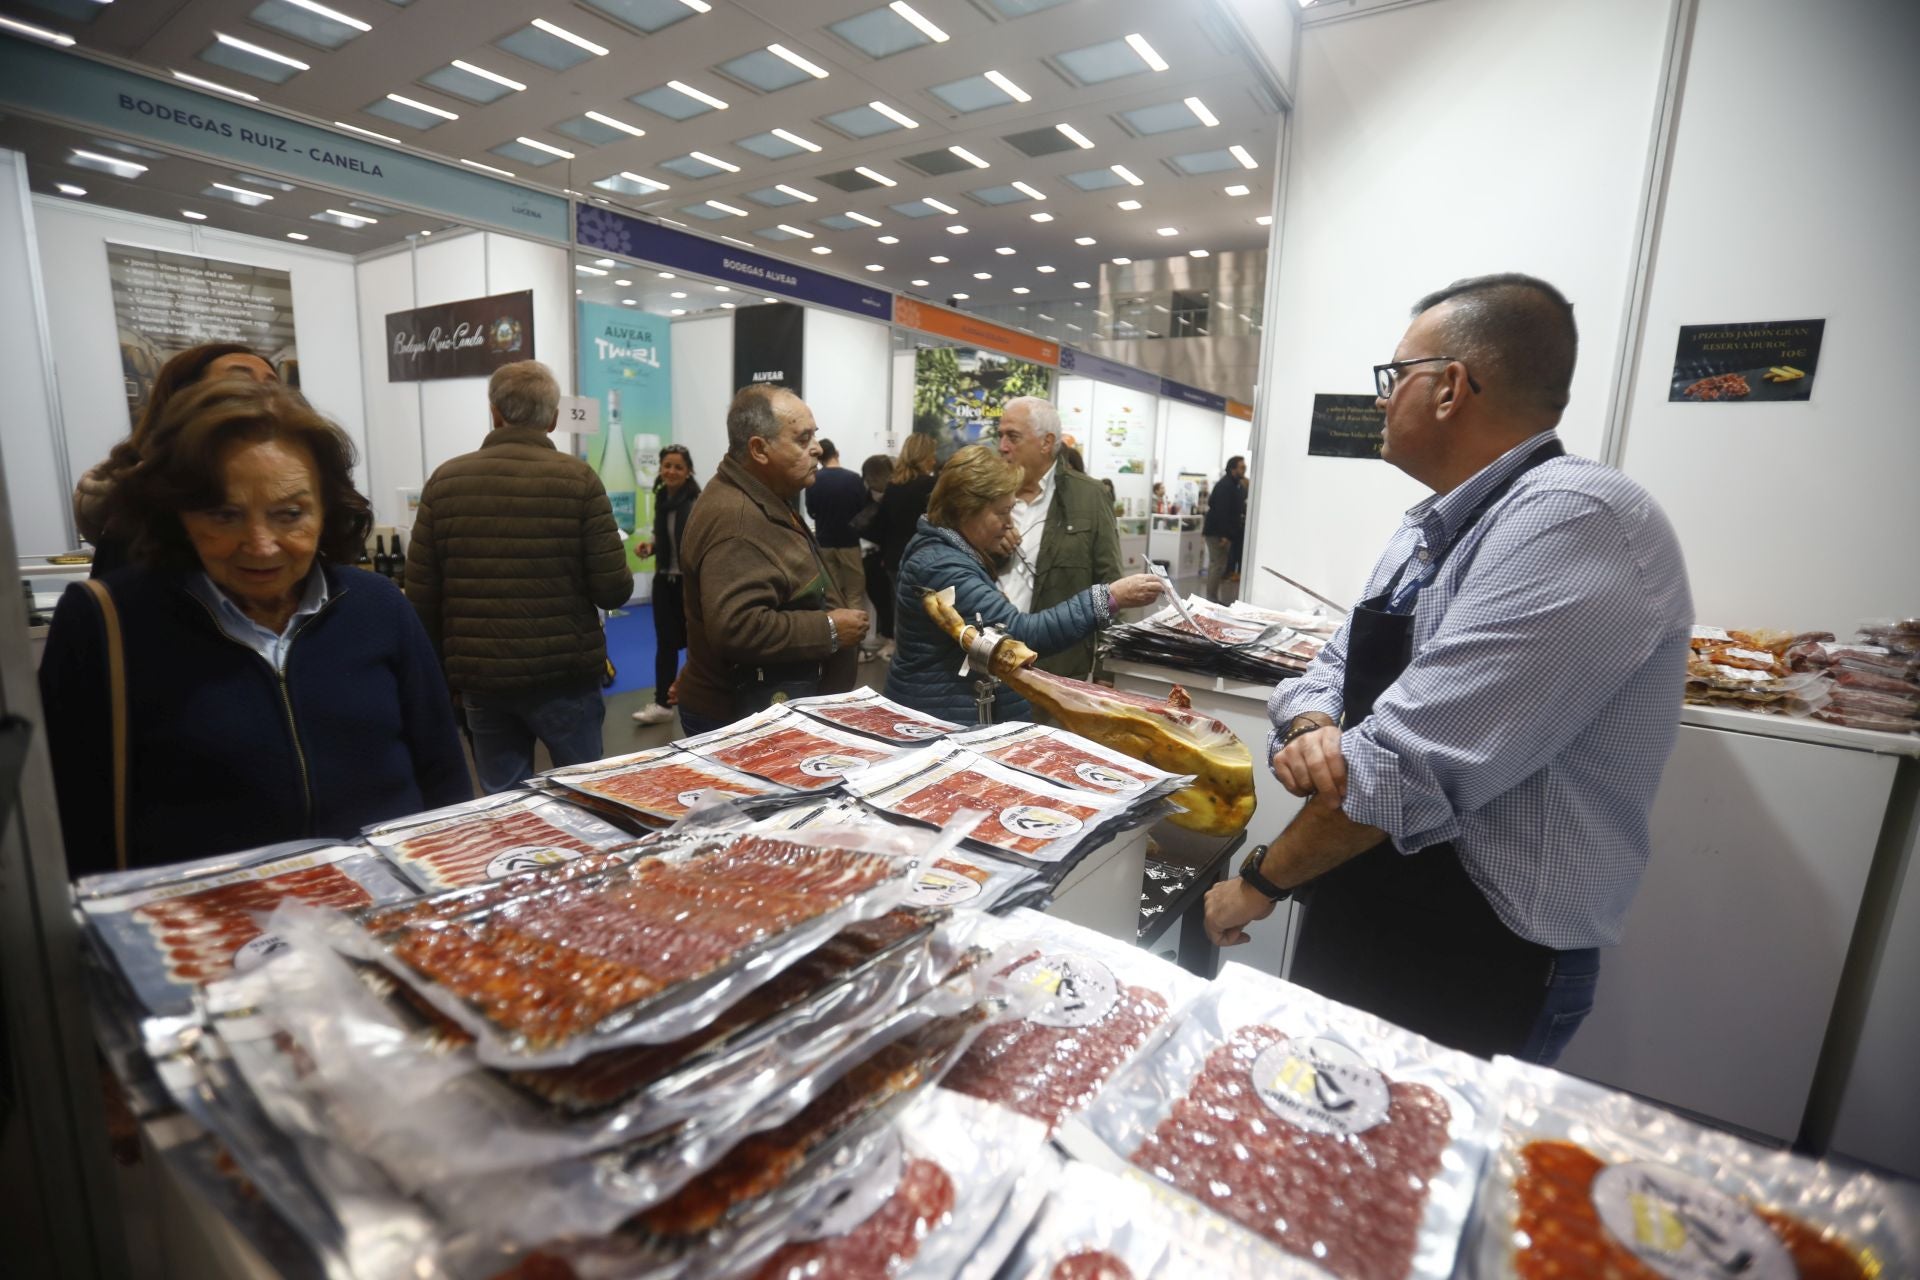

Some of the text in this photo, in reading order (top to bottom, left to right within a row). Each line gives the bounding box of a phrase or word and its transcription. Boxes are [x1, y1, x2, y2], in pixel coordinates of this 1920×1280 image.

[118, 94, 233, 138] BODEGAS
[240, 128, 288, 153] RUIZ
[309, 148, 384, 178] CANELA
[512, 206, 542, 219] LUCENA
[723, 258, 798, 286] BODEGAS ALVEAR
[604, 326, 653, 343] ALVEAR
[1703, 341, 1750, 351] RESERVA
[753, 371, 784, 382] ALVEAR
[571, 408, 586, 421] 32
